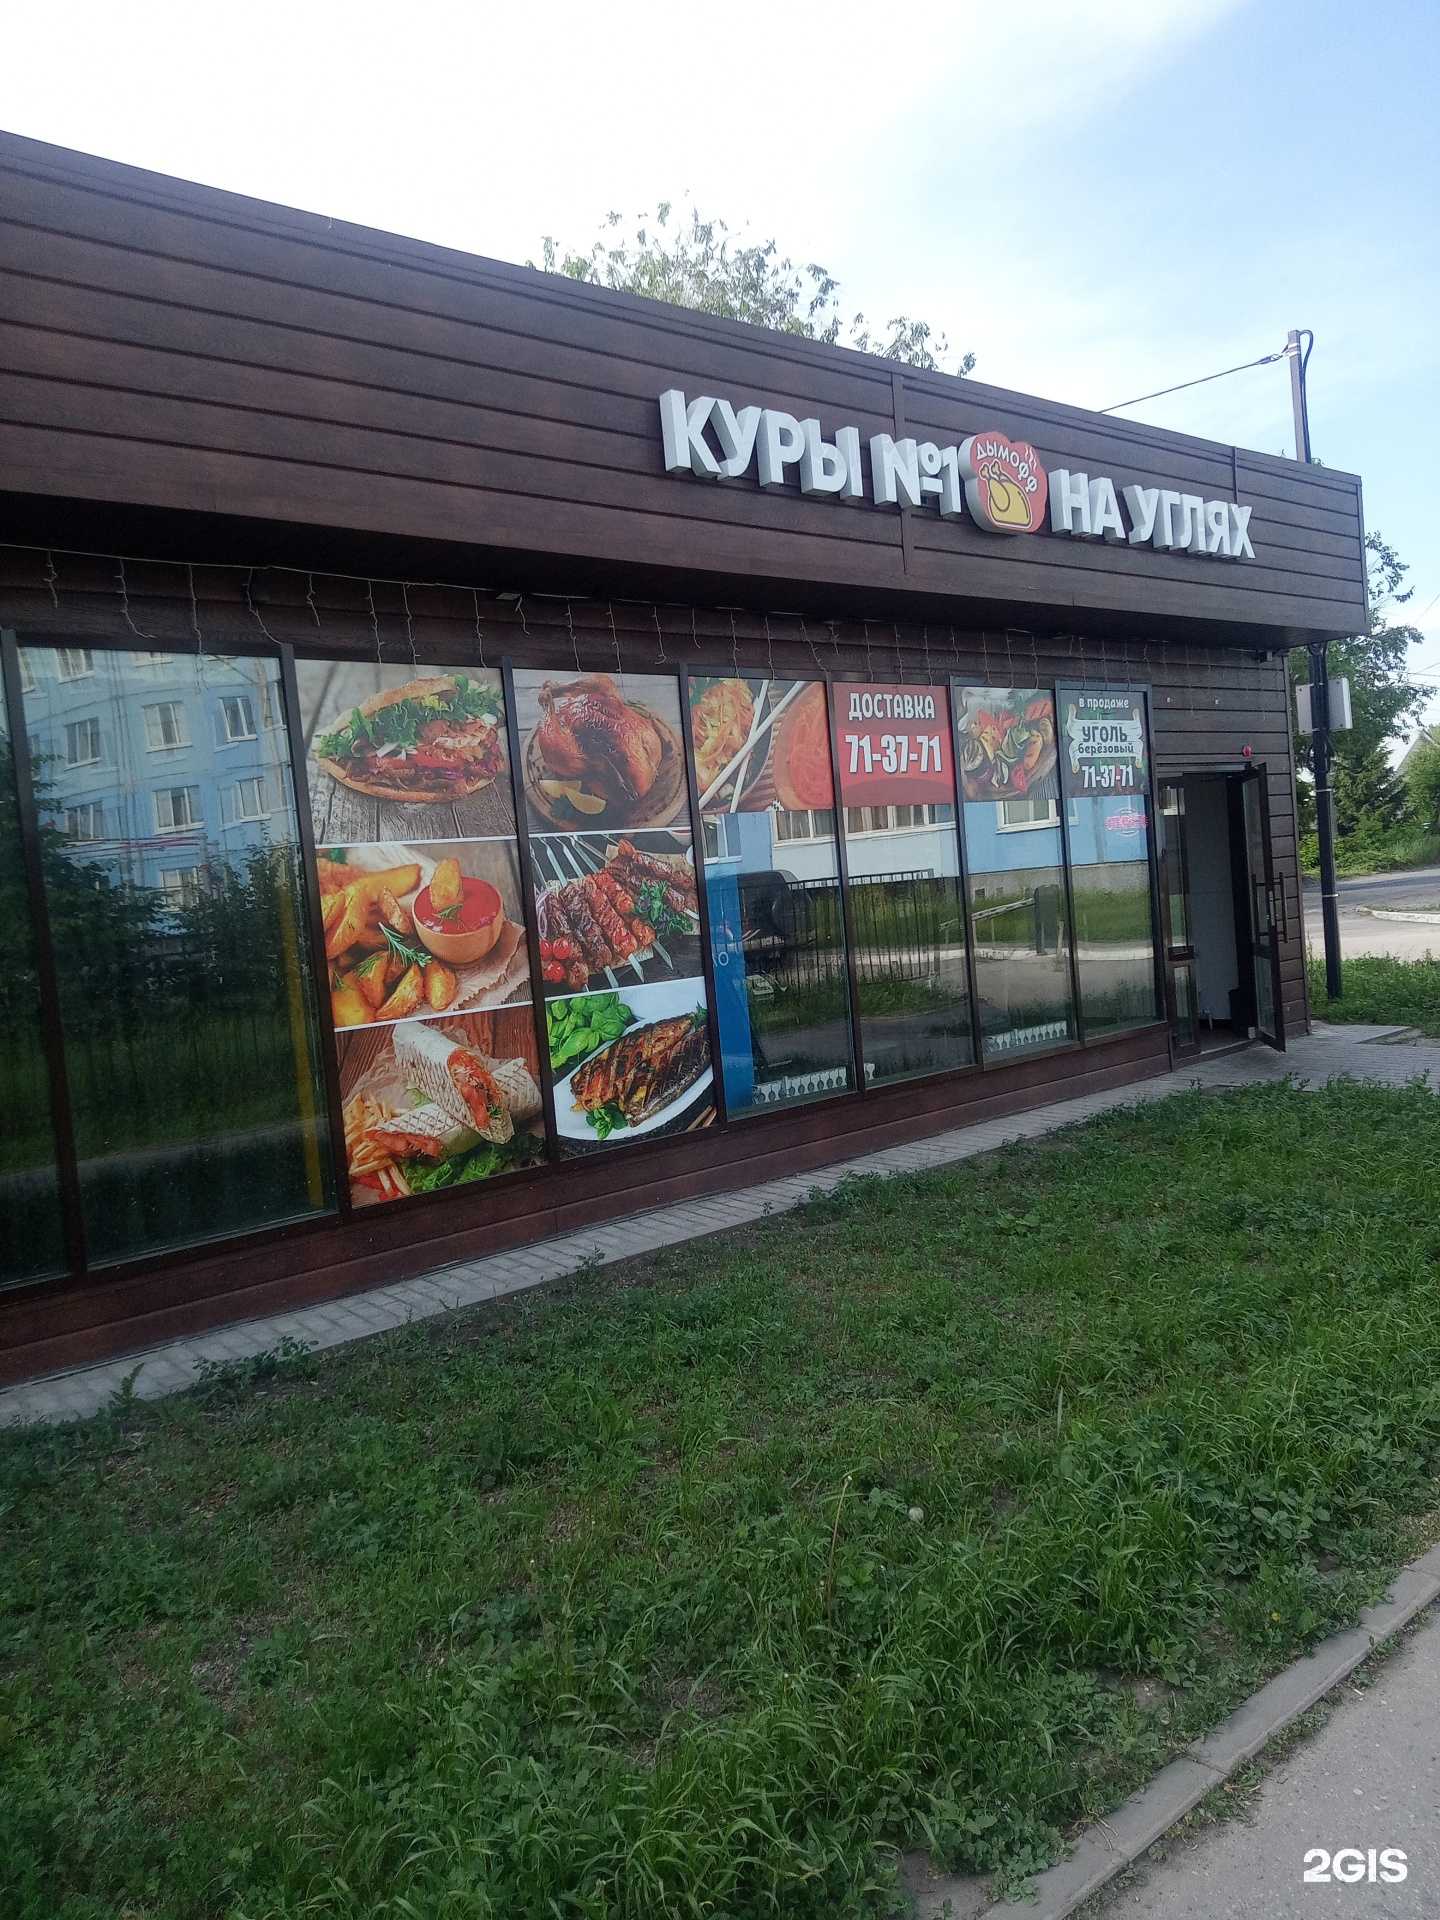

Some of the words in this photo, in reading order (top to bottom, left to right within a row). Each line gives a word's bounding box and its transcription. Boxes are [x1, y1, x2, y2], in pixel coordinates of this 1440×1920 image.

[659, 389, 864, 499] КУРЫ
[870, 433, 962, 517] №1
[976, 440, 1037, 493] ДЫМОФФ
[1047, 468, 1126, 539] НА
[1121, 484, 1255, 559] УГЛЯХ
[849, 692, 936, 720] ДОСТАВКА
[1079, 698, 1086, 708] в
[1087, 697, 1129, 711] продаже
[1082, 725, 1128, 742] УГОЛЬ
[845, 734, 942, 773] 71-37-71
[1078, 743, 1134, 756] берёзовый
[1081, 764, 1134, 788] 71-37-71
